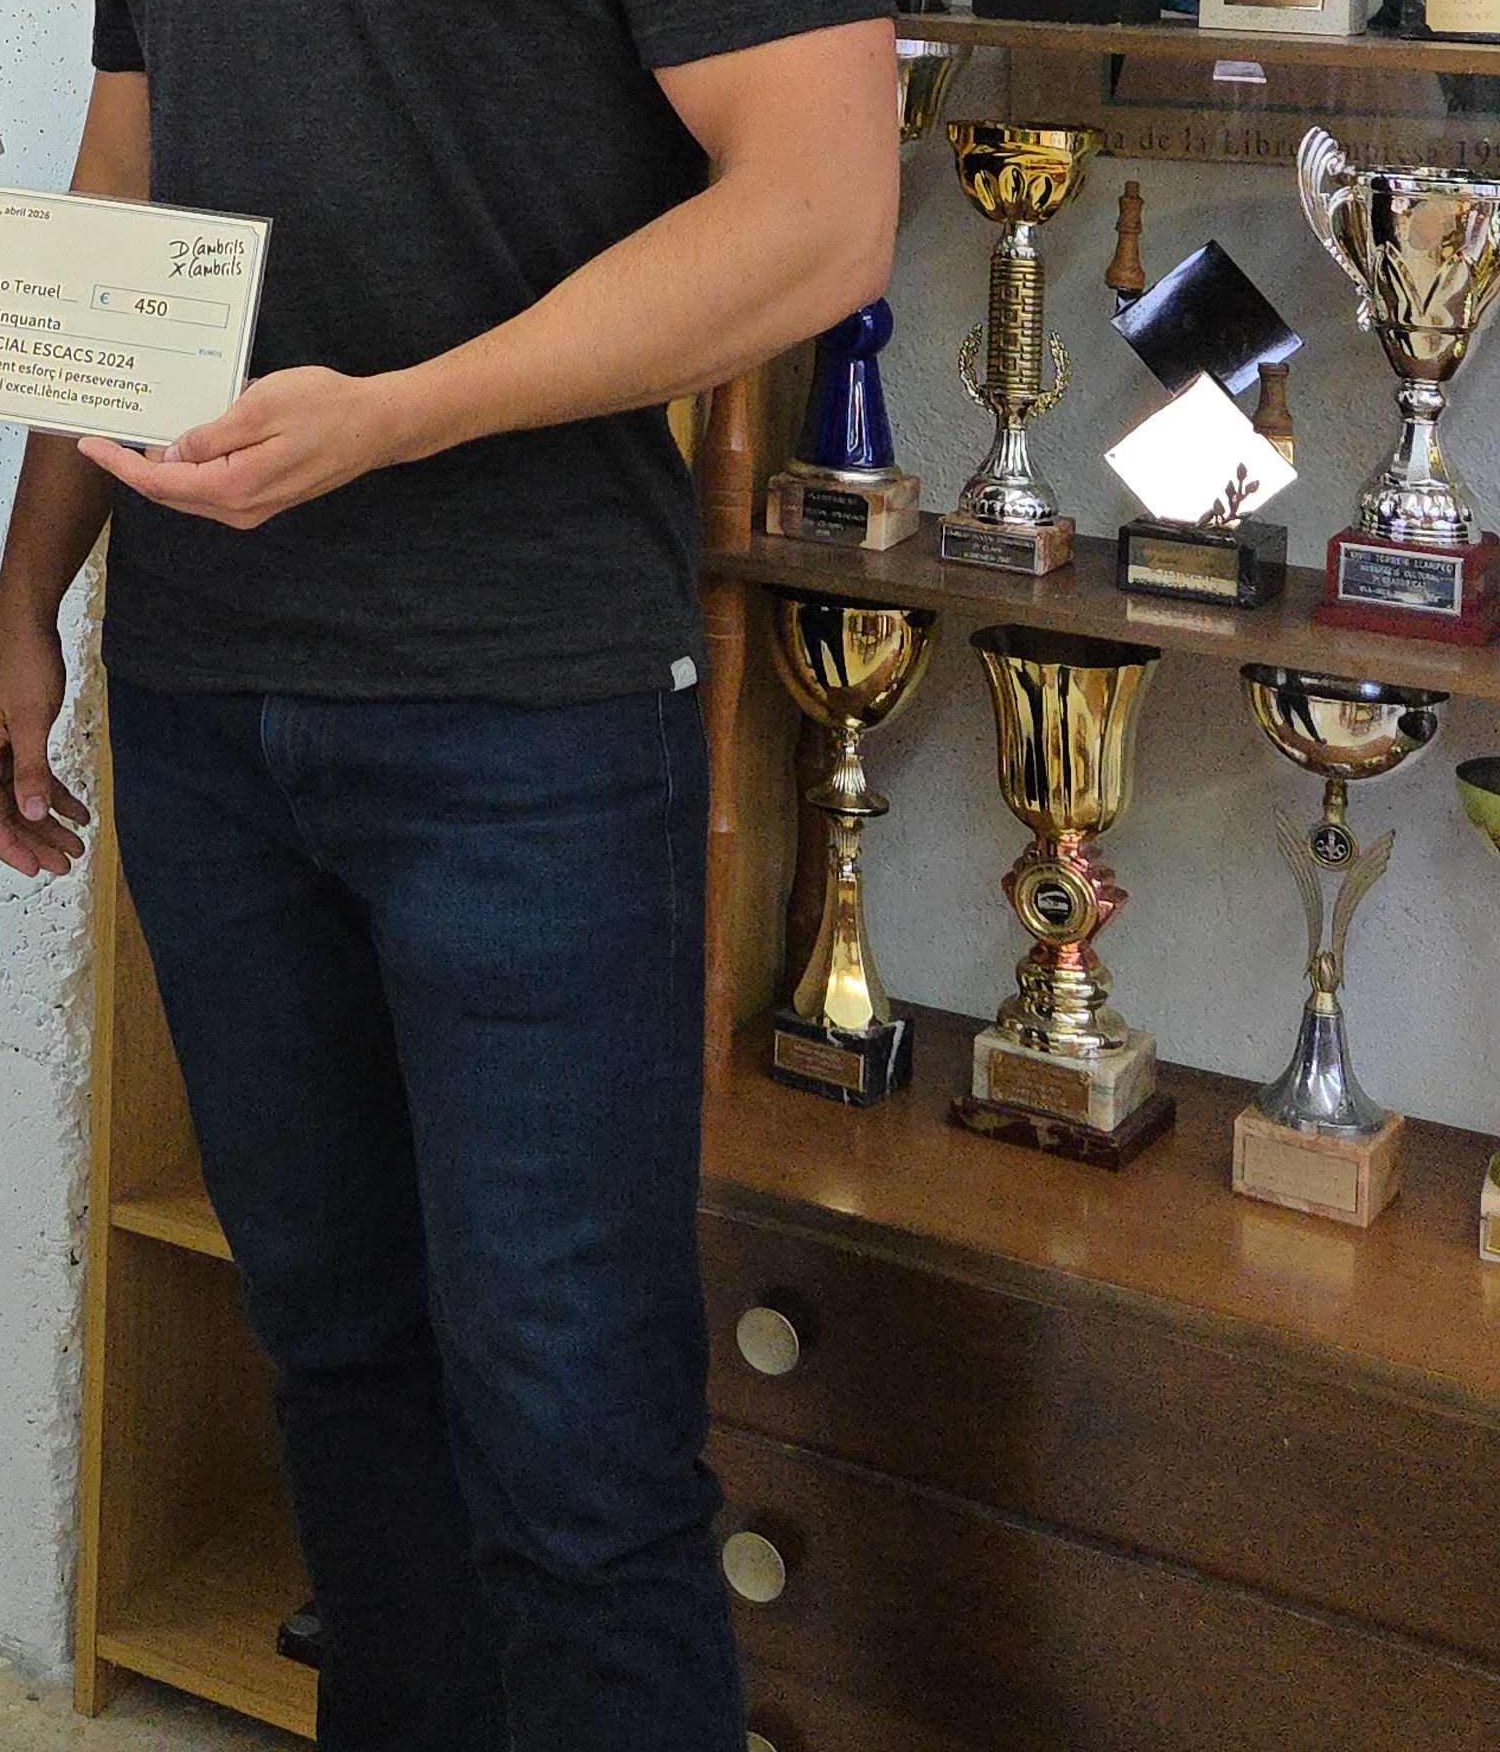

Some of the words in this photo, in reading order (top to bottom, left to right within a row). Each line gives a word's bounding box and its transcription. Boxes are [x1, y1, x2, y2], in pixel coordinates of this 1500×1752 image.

[4, 205, 26, 218] abril
[27, 208, 51, 221] 2026
[192, 236, 245, 259] Cambrils
[188, 256, 243, 279] Cambrils
[13, 279, 62, 299] Teruel
[134, 297, 169, 318] 450
[32, 341, 94, 364] ESCACS
[96, 350, 136, 370] 2024
[18, 363, 56, 382] esforç
[64, 369, 153, 395] perseverança.
[80, 393, 144, 413] esportiva.
